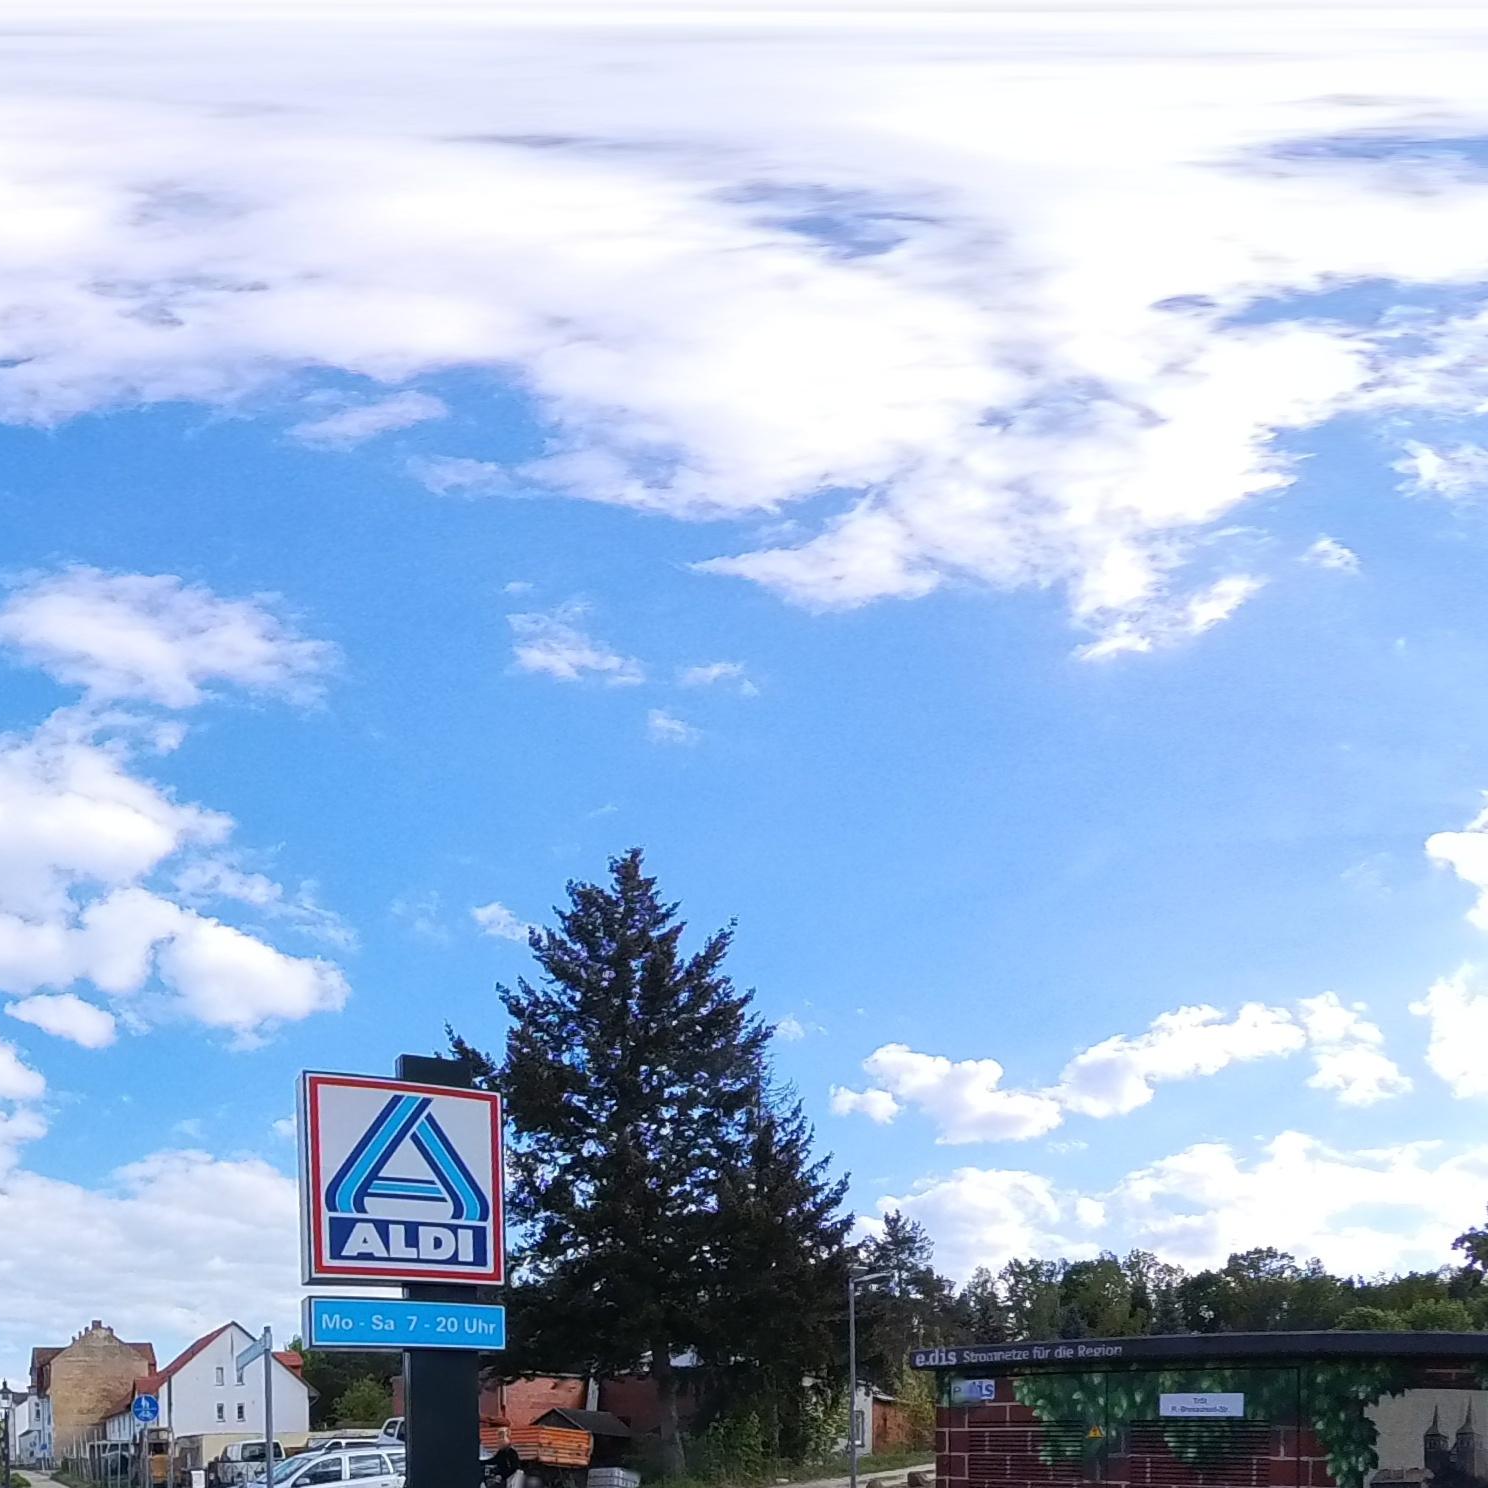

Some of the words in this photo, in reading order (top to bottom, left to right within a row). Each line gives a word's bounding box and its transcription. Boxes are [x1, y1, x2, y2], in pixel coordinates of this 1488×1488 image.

[340, 1222, 474, 1262] ALDI
[321, 1313, 353, 1331] Mo
[371, 1314, 395, 1331] Sa
[406, 1315, 418, 1331] 7
[436, 1316, 458, 1333] 20
[464, 1317, 496, 1334] Uhr
[915, 1349, 957, 1366] e.dis
[963, 1349, 1029, 1363] Stromnetze
[1033, 1346, 1051, 1360] für
[1054, 1345, 1074, 1359] die
[1078, 1344, 1123, 1359] Region
